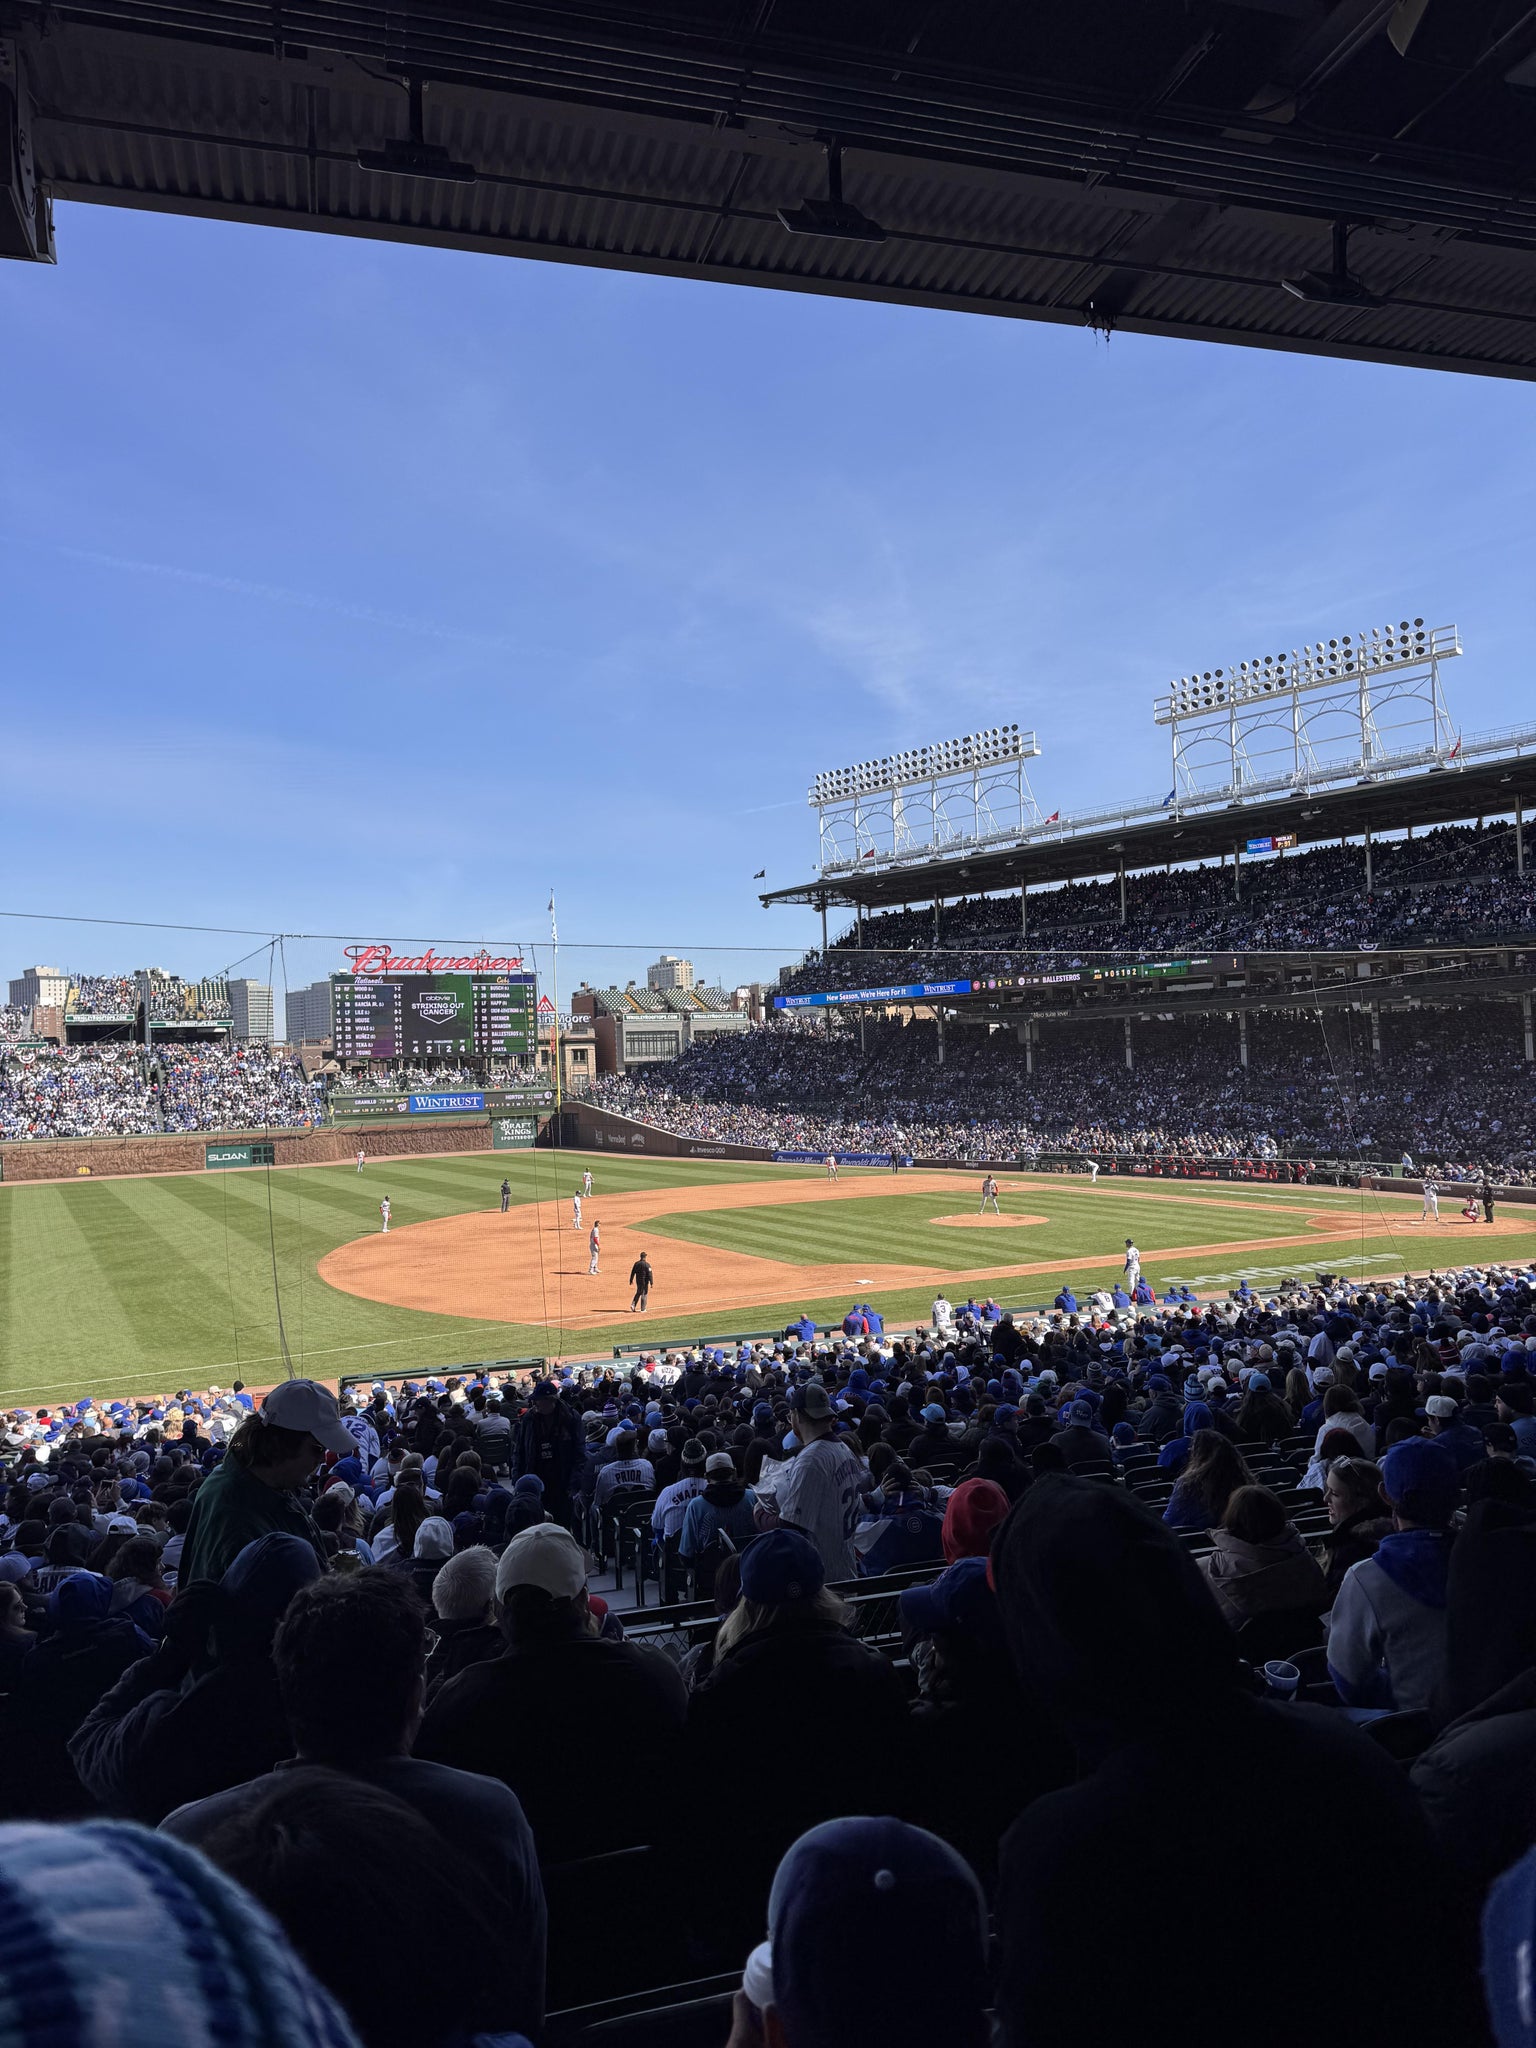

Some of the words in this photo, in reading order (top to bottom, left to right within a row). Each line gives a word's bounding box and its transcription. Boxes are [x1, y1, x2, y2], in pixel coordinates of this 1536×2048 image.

[344, 945, 524, 974] Budweiser
[354, 975, 384, 984] Nationals
[1042, 974, 1081, 984] BALLESTEROS
[839, 992, 860, 1000] Season,
[860, 990, 876, 998] We're
[876, 989, 890, 997] Here
[891, 988, 901, 996] For
[923, 984, 955, 993] WINTRUST
[413, 1046, 419, 1054] 4
[426, 1045, 433, 1053] 2
[446, 1045, 452, 1053] 2
[459, 1045, 466, 1053] 4
[415, 1096, 480, 1108] WINTRUST
[501, 1122, 532, 1131] DRAFT
[504, 1128, 532, 1136] KINGS
[1160, 1255, 1373, 1287] Southwest
[940, 1305, 946, 1314] 3
[660, 1375, 675, 1385] 44
[615, 1470, 642, 1484] PRIOR
